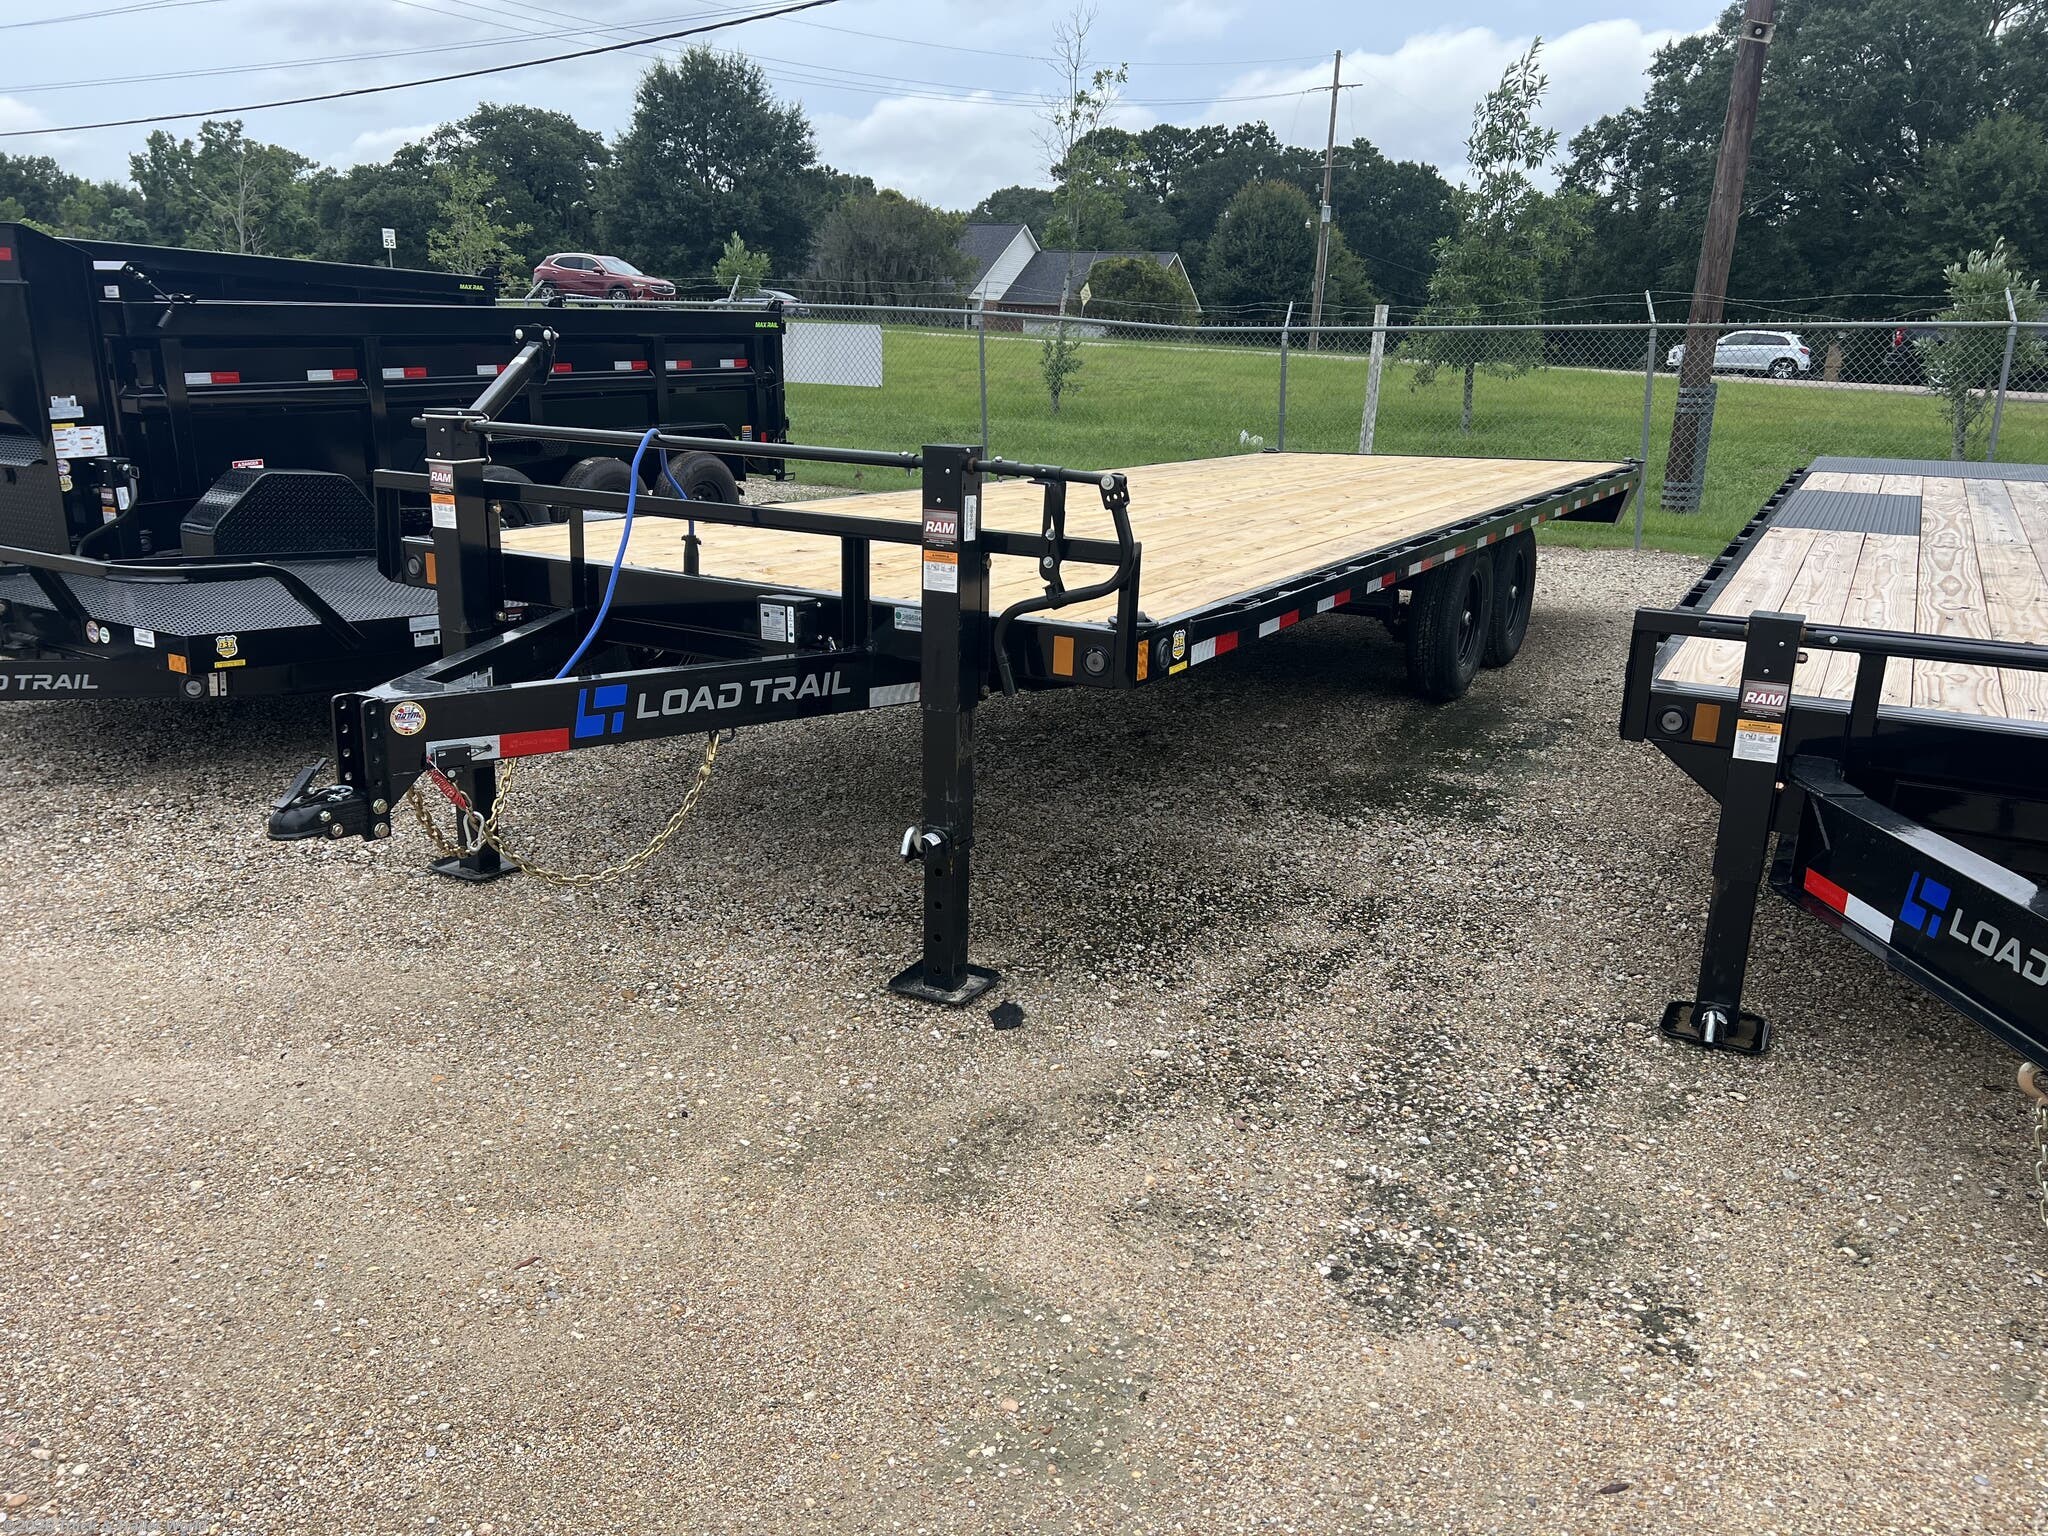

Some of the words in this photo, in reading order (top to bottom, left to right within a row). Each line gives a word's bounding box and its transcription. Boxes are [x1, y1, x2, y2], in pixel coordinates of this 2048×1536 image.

[384, 238, 395, 246] 55
[431, 471, 451, 483] RAM
[925, 520, 955, 534] RAM
[14, 674, 98, 690] TRAIL
[636, 682, 743, 719] LOAD
[750, 670, 851, 704] TRAIL
[1744, 691, 1784, 706] RAM
[1949, 908, 2048, 986] LOAD
